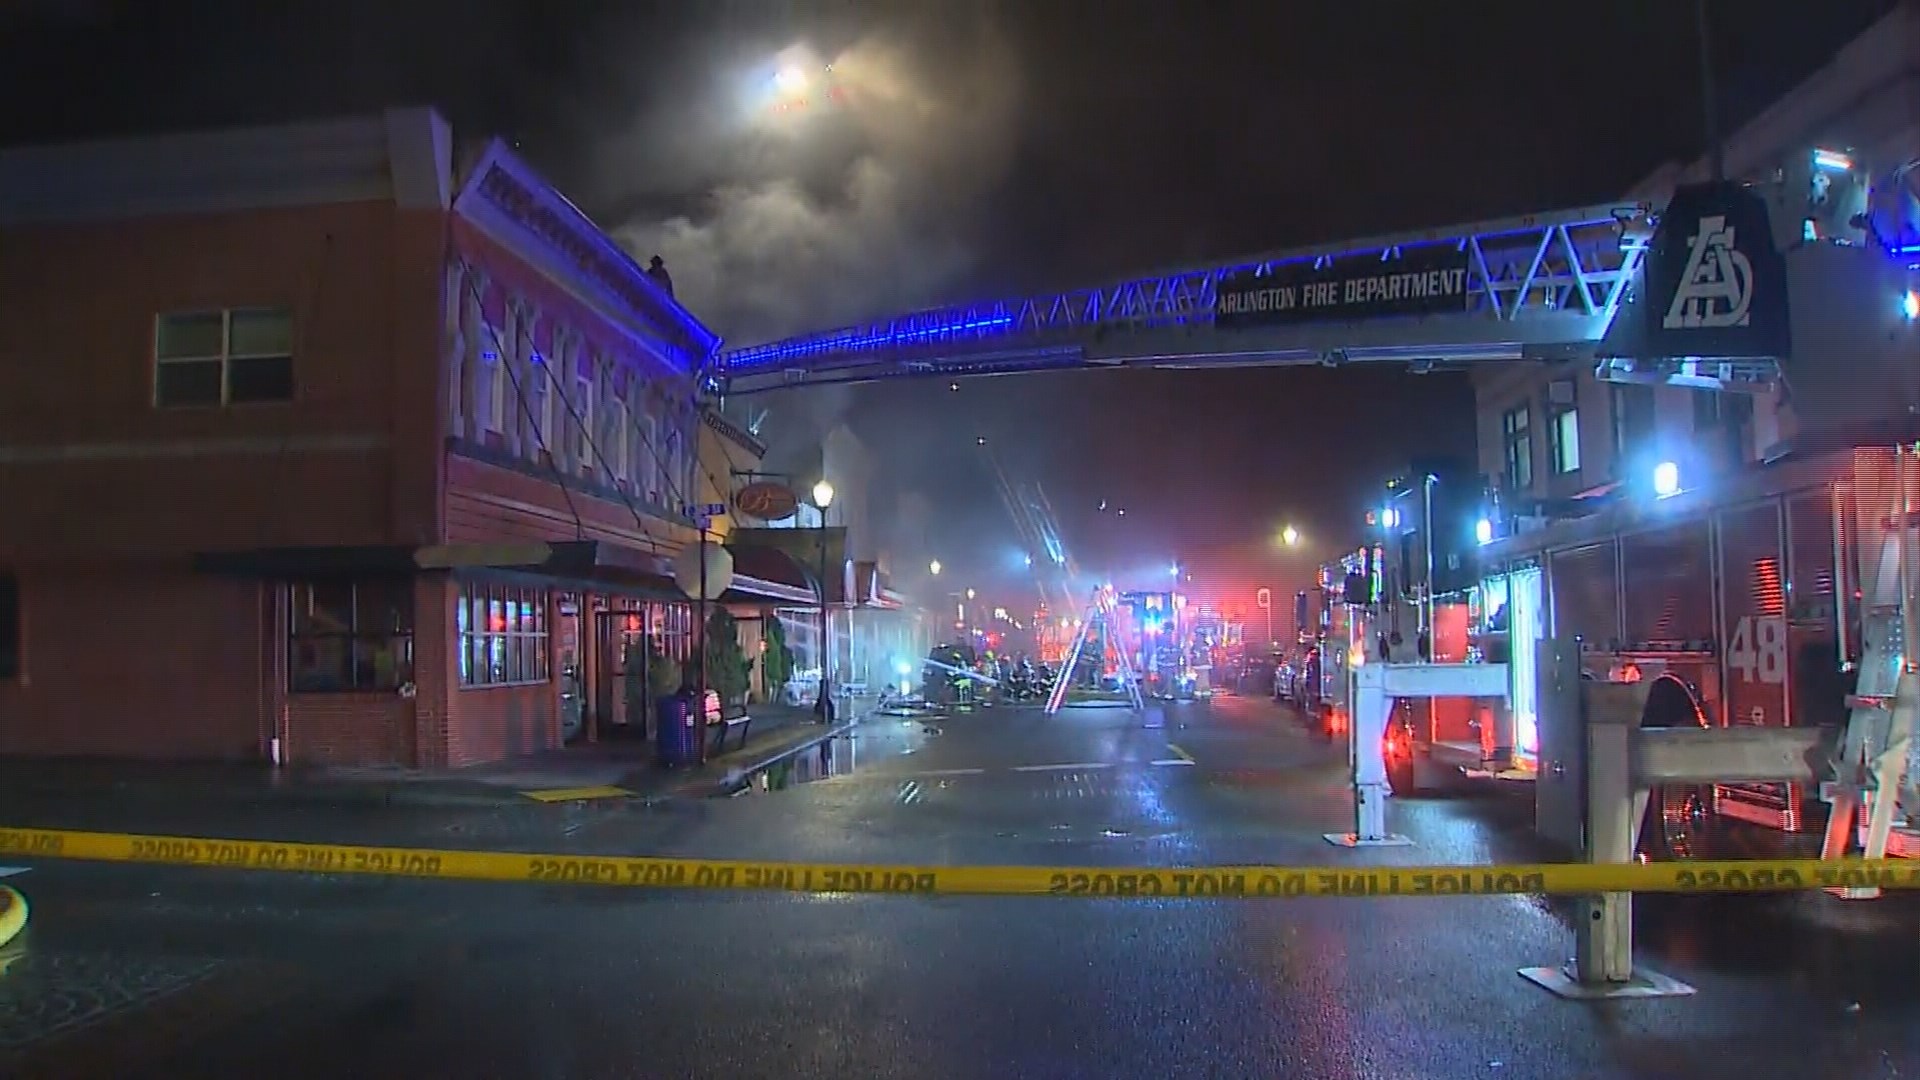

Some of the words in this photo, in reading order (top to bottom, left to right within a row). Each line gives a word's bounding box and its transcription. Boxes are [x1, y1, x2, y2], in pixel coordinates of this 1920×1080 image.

[1218, 286, 1297, 315] ARLINGTON
[1303, 281, 1339, 308] FIRE
[1345, 268, 1466, 304] DEPARTMENT
[1728, 616, 1785, 683] 48
